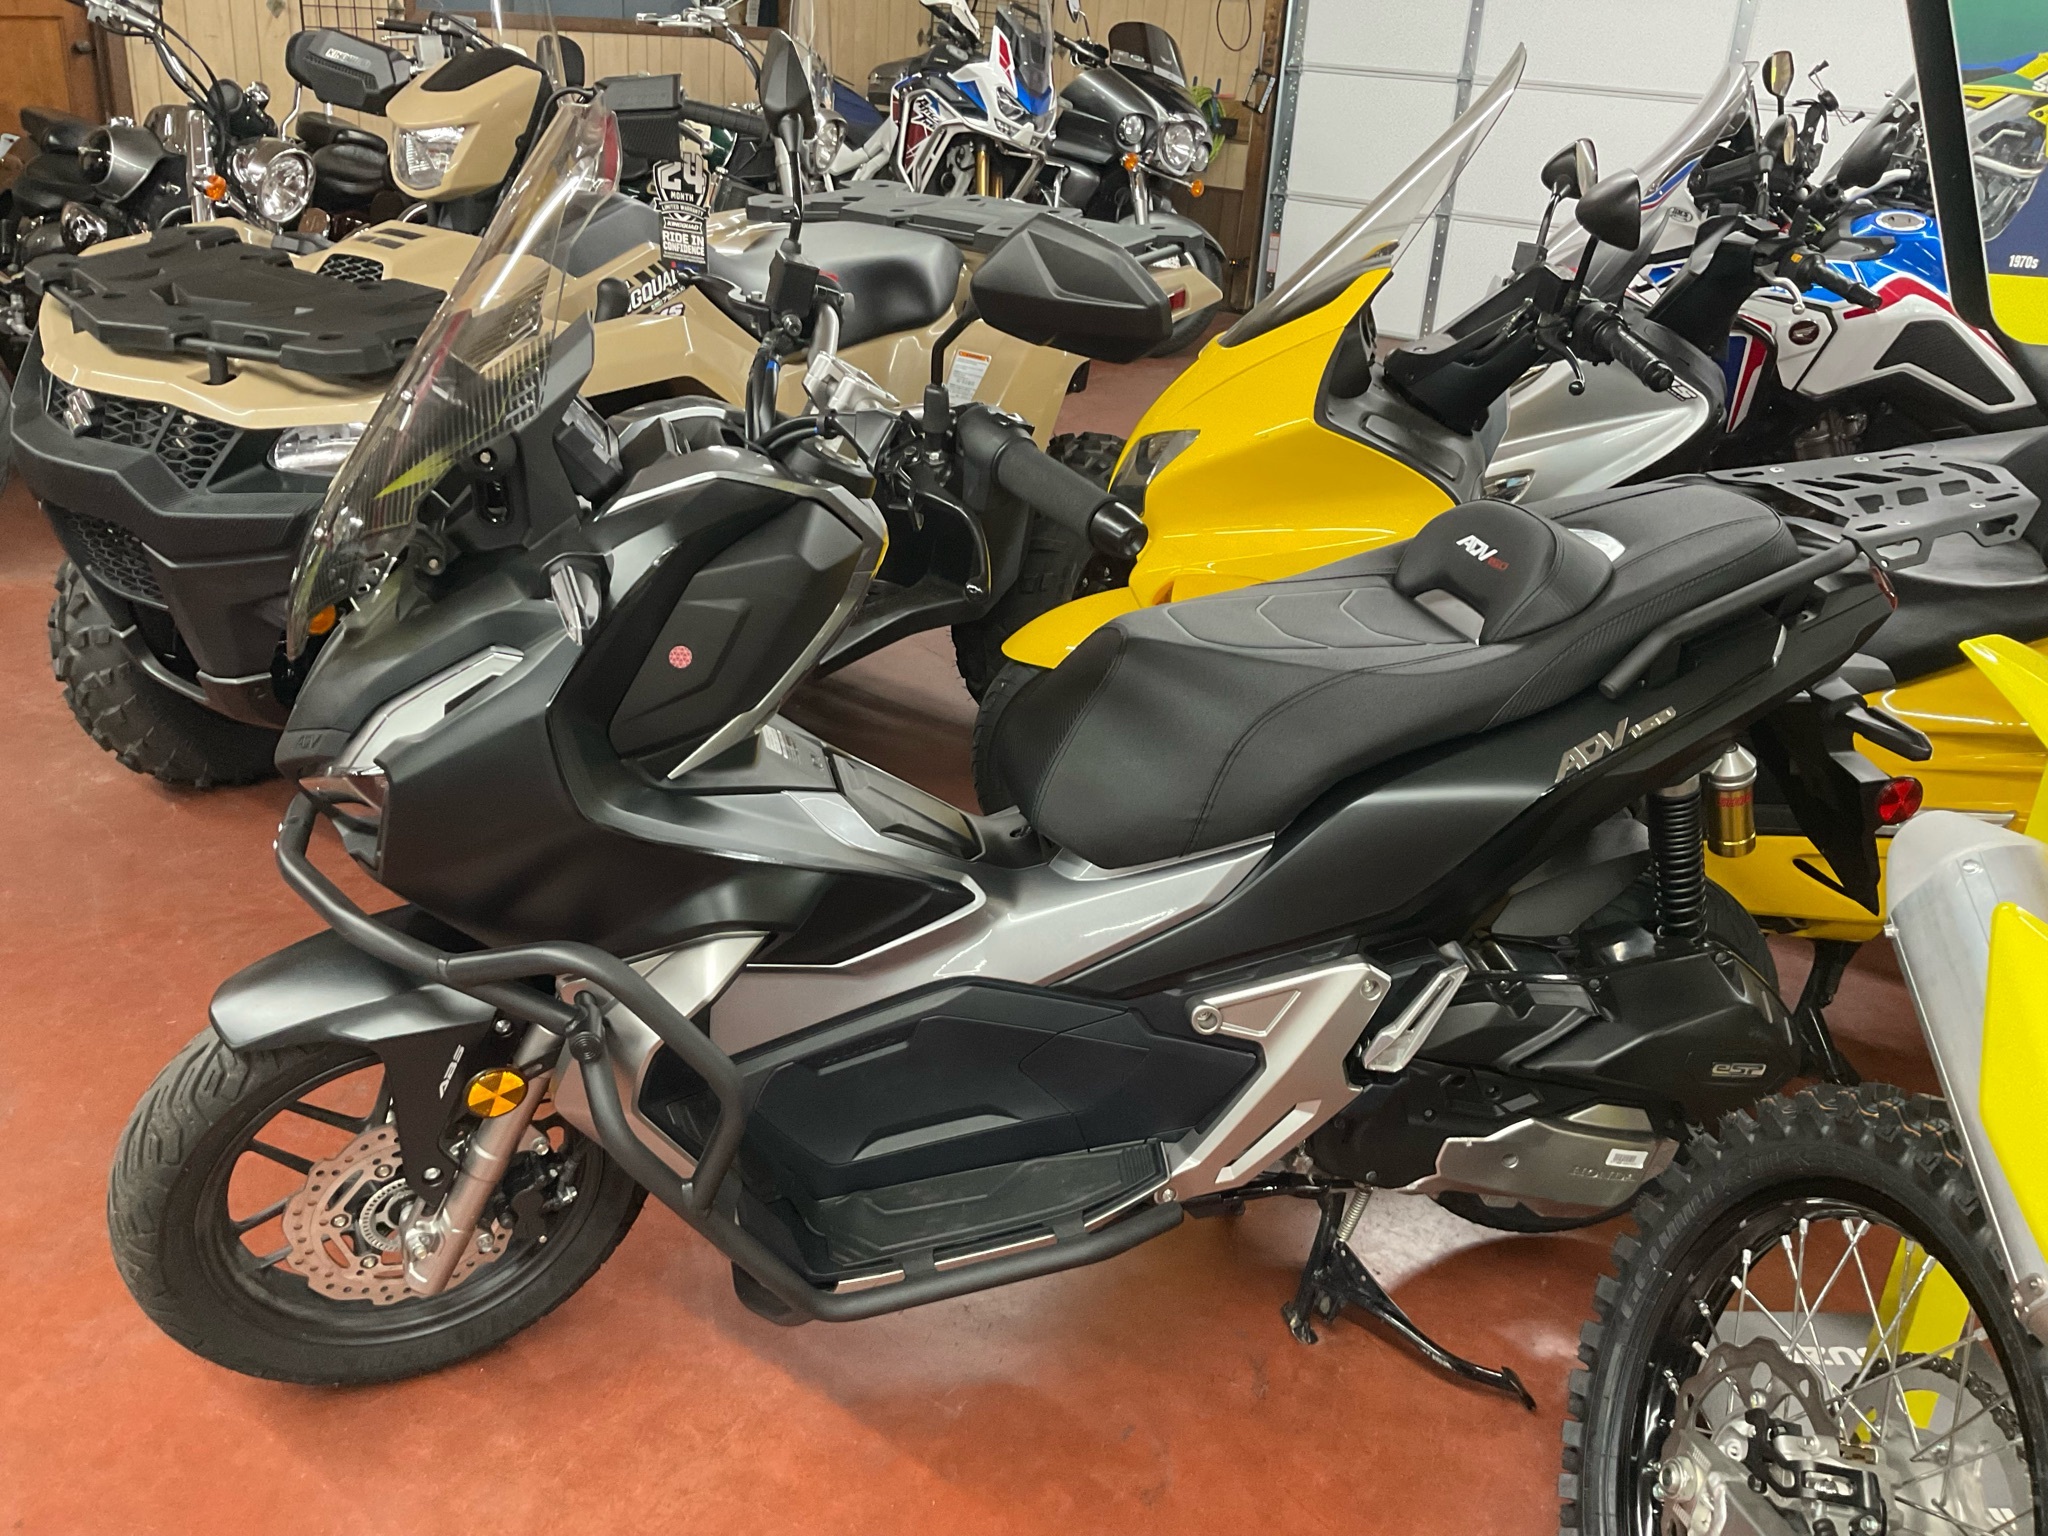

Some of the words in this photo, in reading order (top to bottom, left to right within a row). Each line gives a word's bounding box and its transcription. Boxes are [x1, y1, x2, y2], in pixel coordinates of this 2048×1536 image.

[660, 152, 706, 194] 24
[670, 190, 695, 202] MONTH
[662, 230, 689, 245] RIDE
[690, 234, 705, 247] IN
[662, 241, 706, 257] CONFIDENCE
[2009, 254, 2040, 269] 1970s
[438, 1044, 465, 1100] ABS
